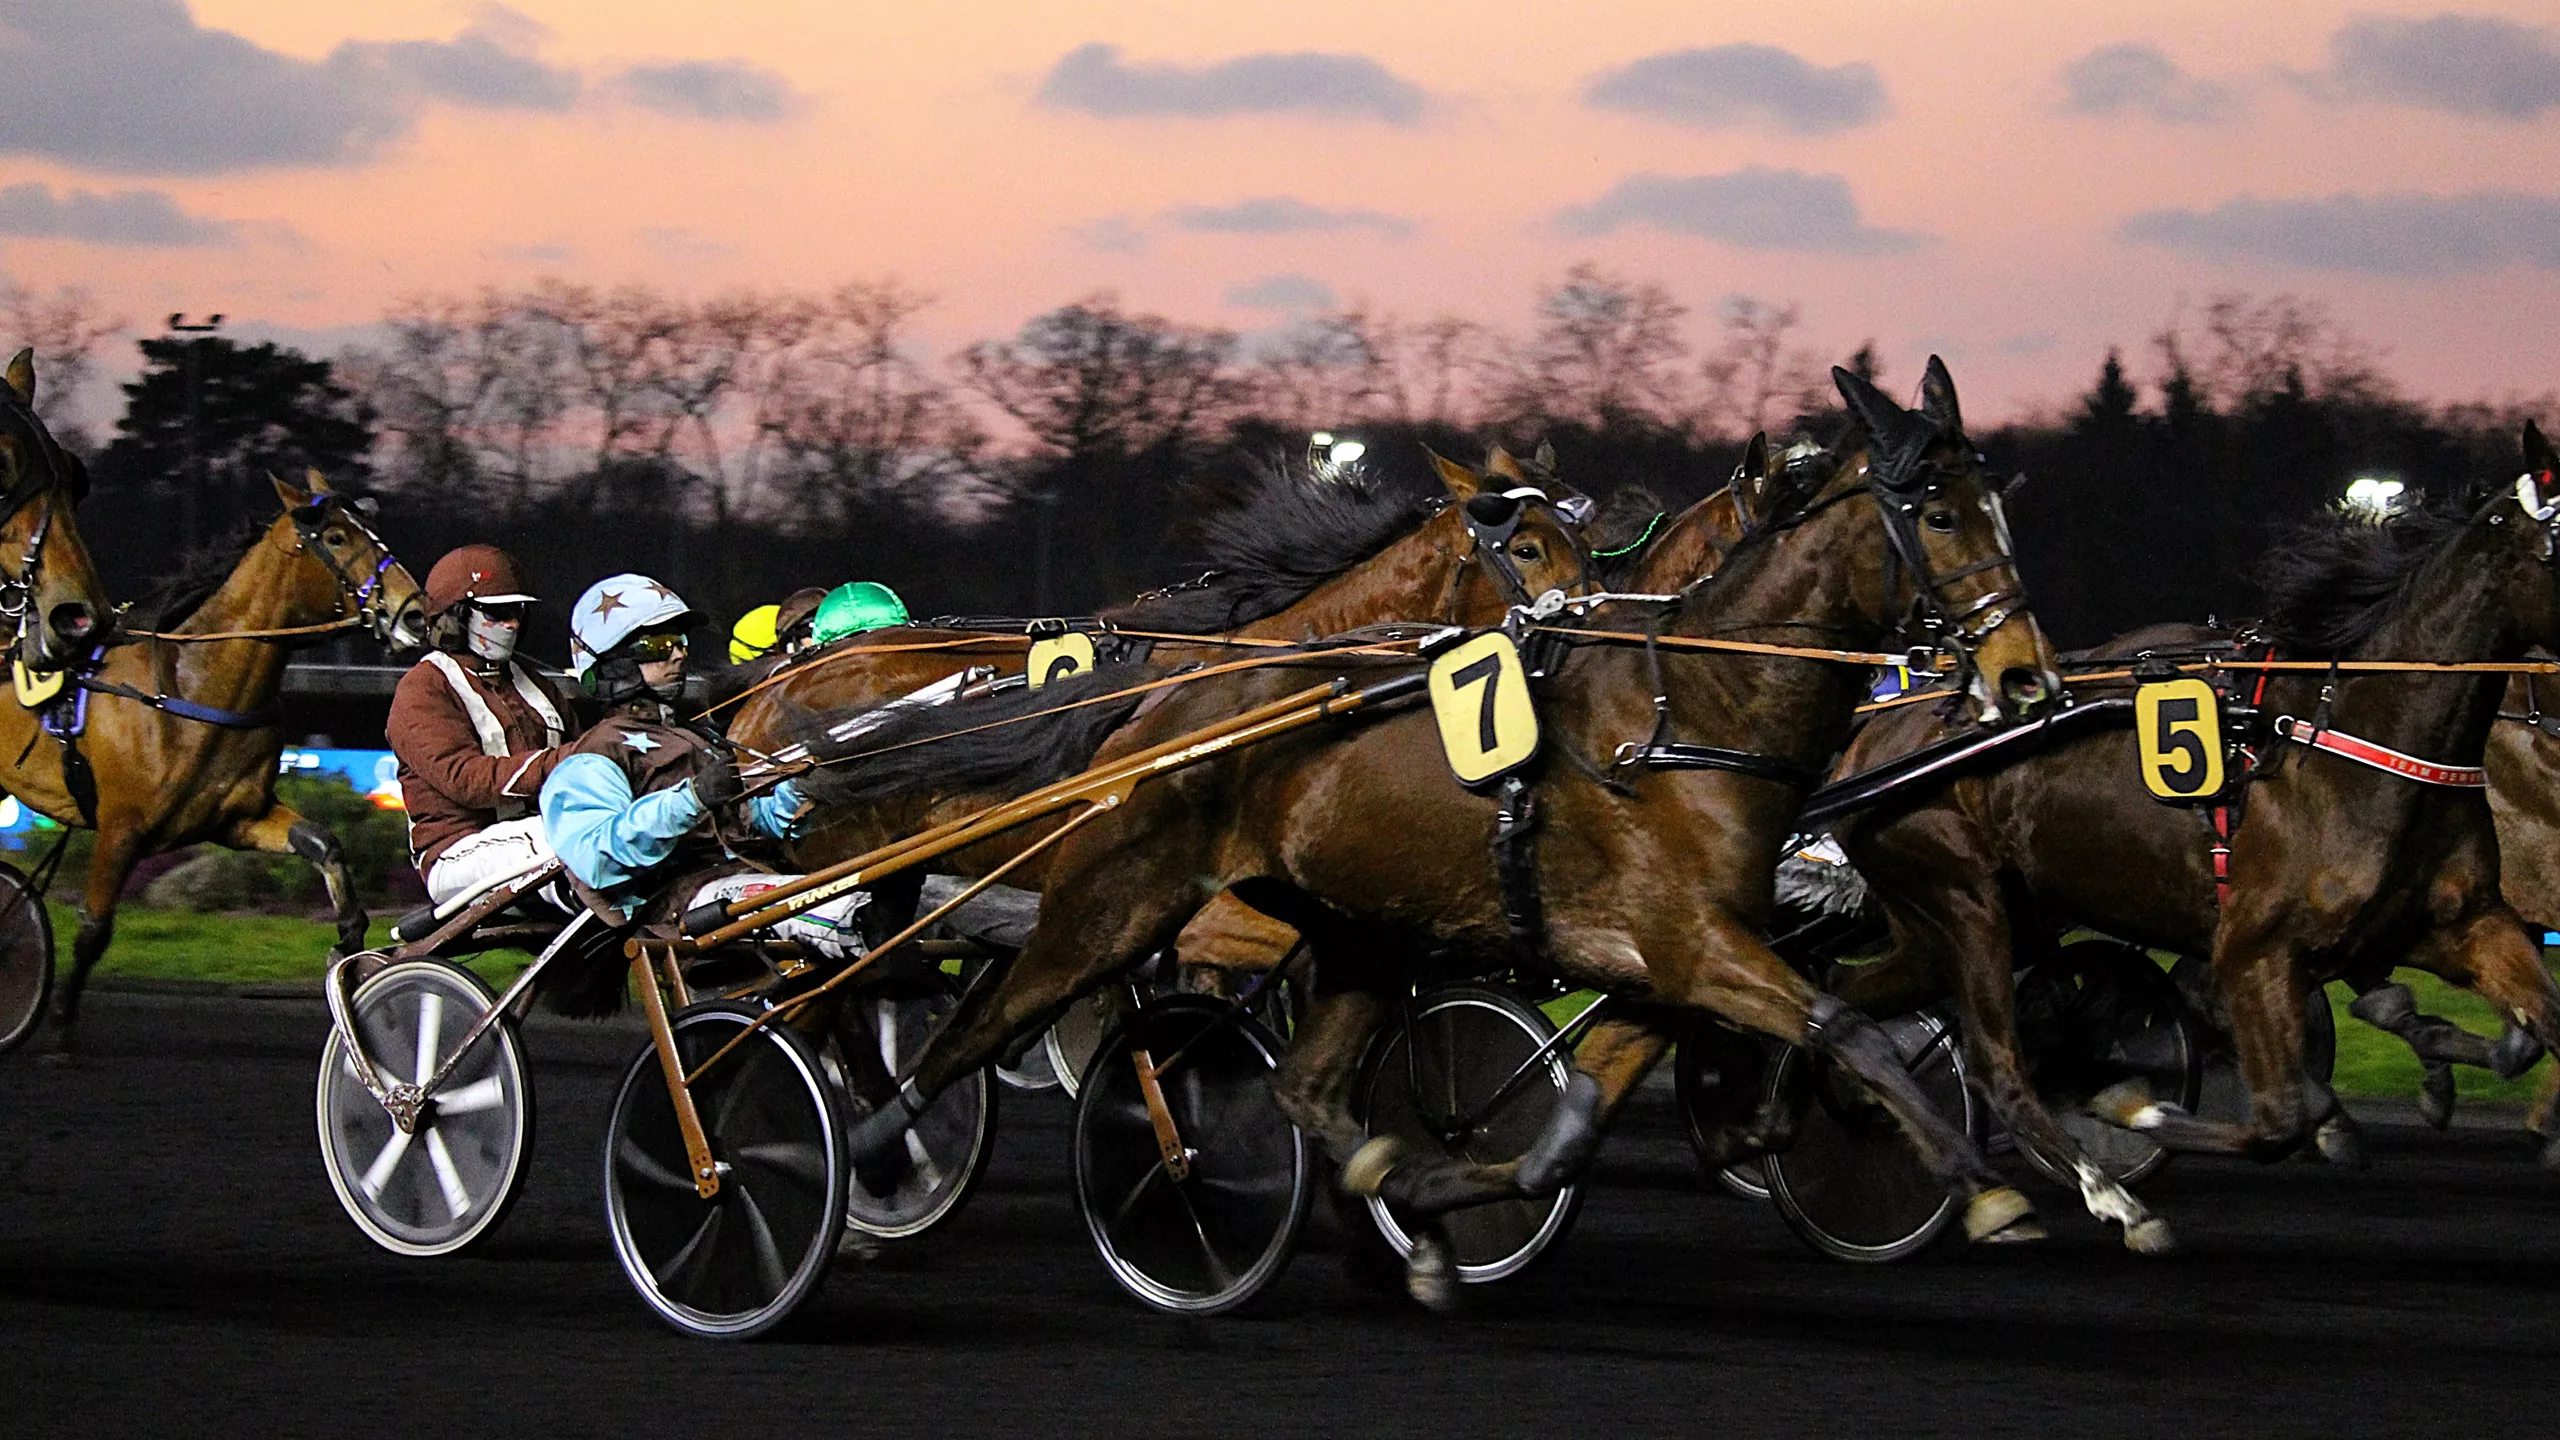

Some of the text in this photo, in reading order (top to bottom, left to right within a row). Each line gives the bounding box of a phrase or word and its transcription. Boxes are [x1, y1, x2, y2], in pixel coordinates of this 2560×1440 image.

[1451, 652, 1502, 755] 7
[2157, 698, 2208, 794] 5
[2388, 757, 2432, 777] TEAM
[787, 872, 863, 911] YANKEE
